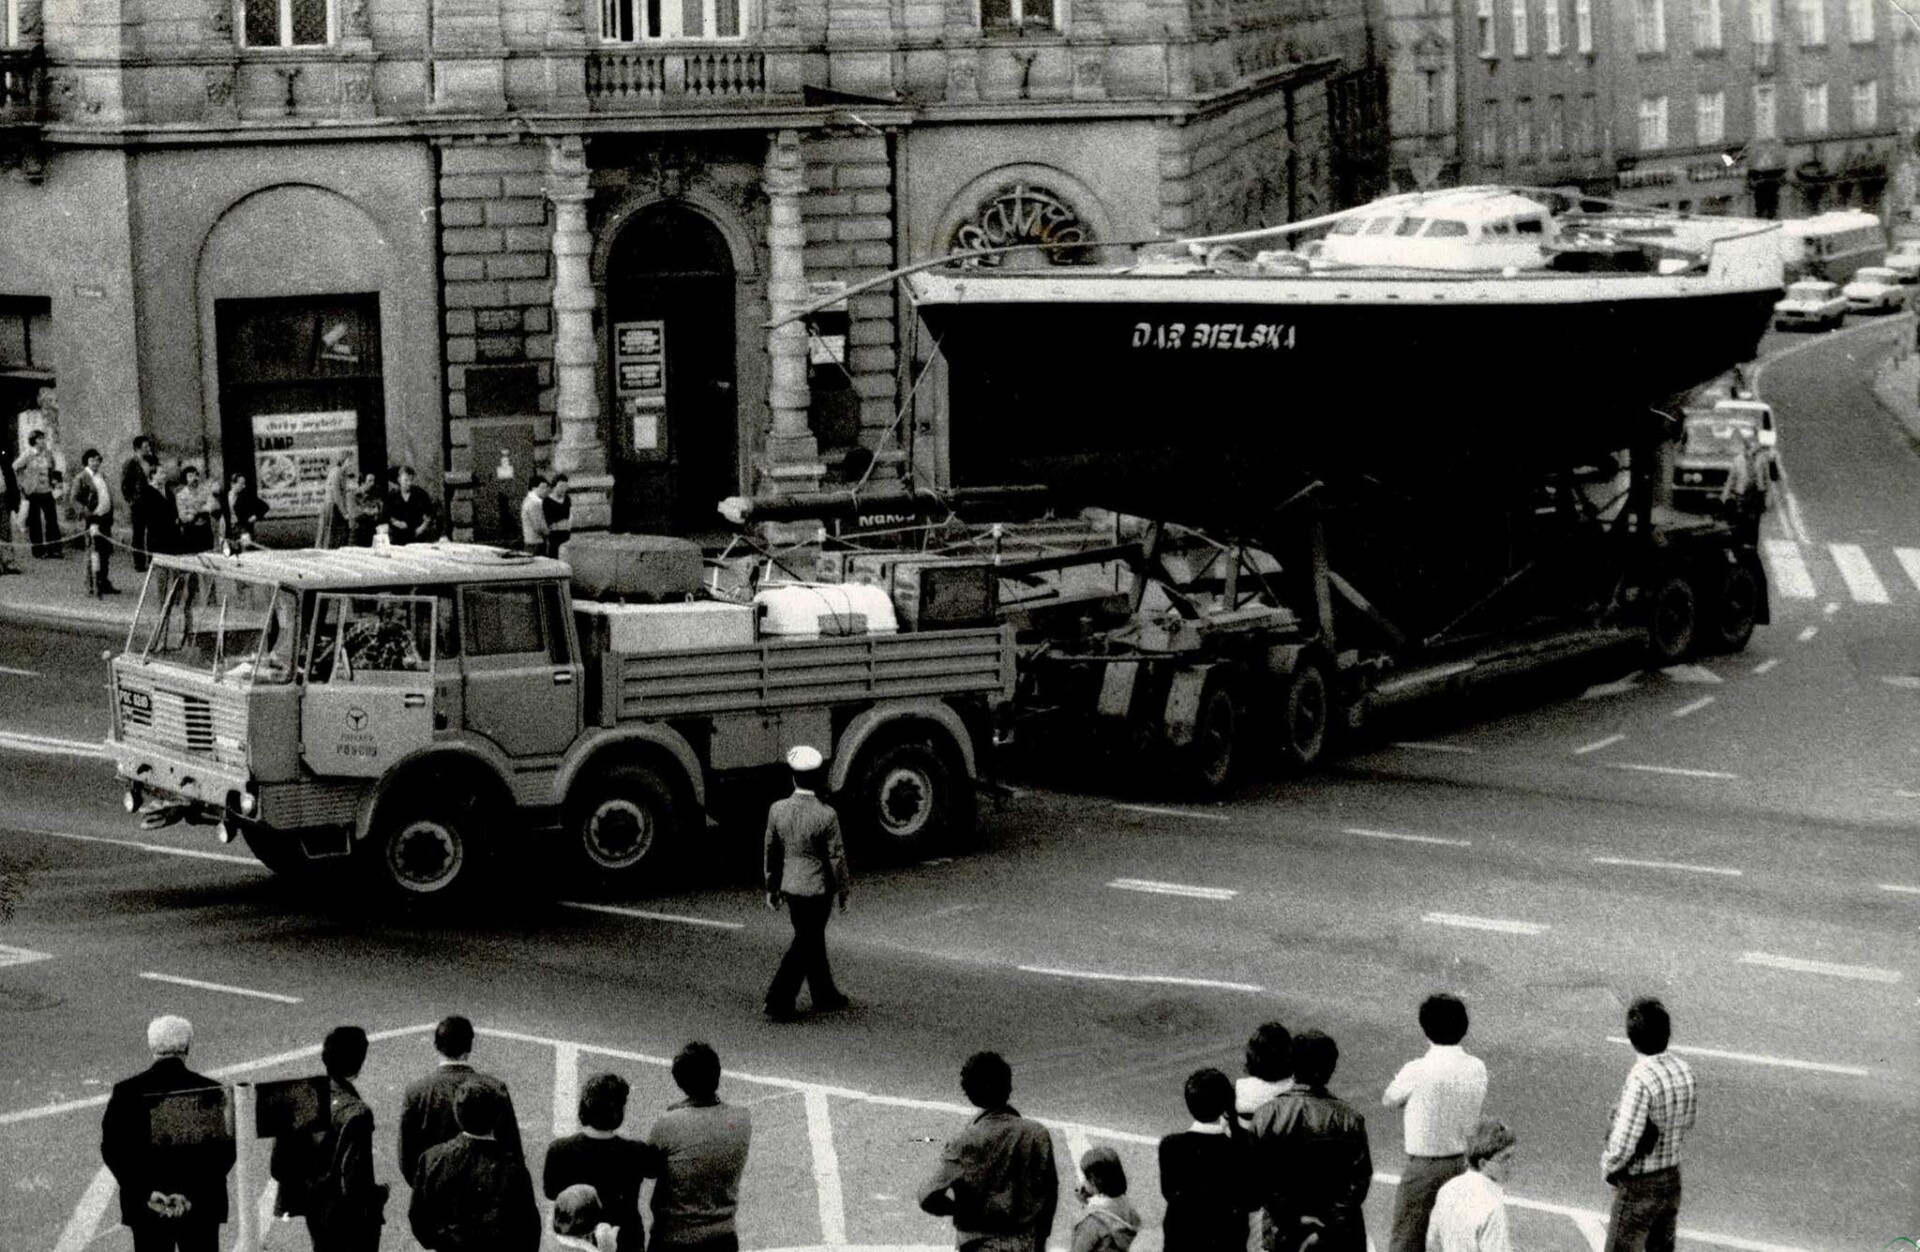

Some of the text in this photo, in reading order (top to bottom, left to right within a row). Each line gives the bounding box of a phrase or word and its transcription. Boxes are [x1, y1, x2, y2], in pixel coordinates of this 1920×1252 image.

[1131, 322, 1296, 350] DAR BIELSKA
[258, 436, 294, 451] LAMP
